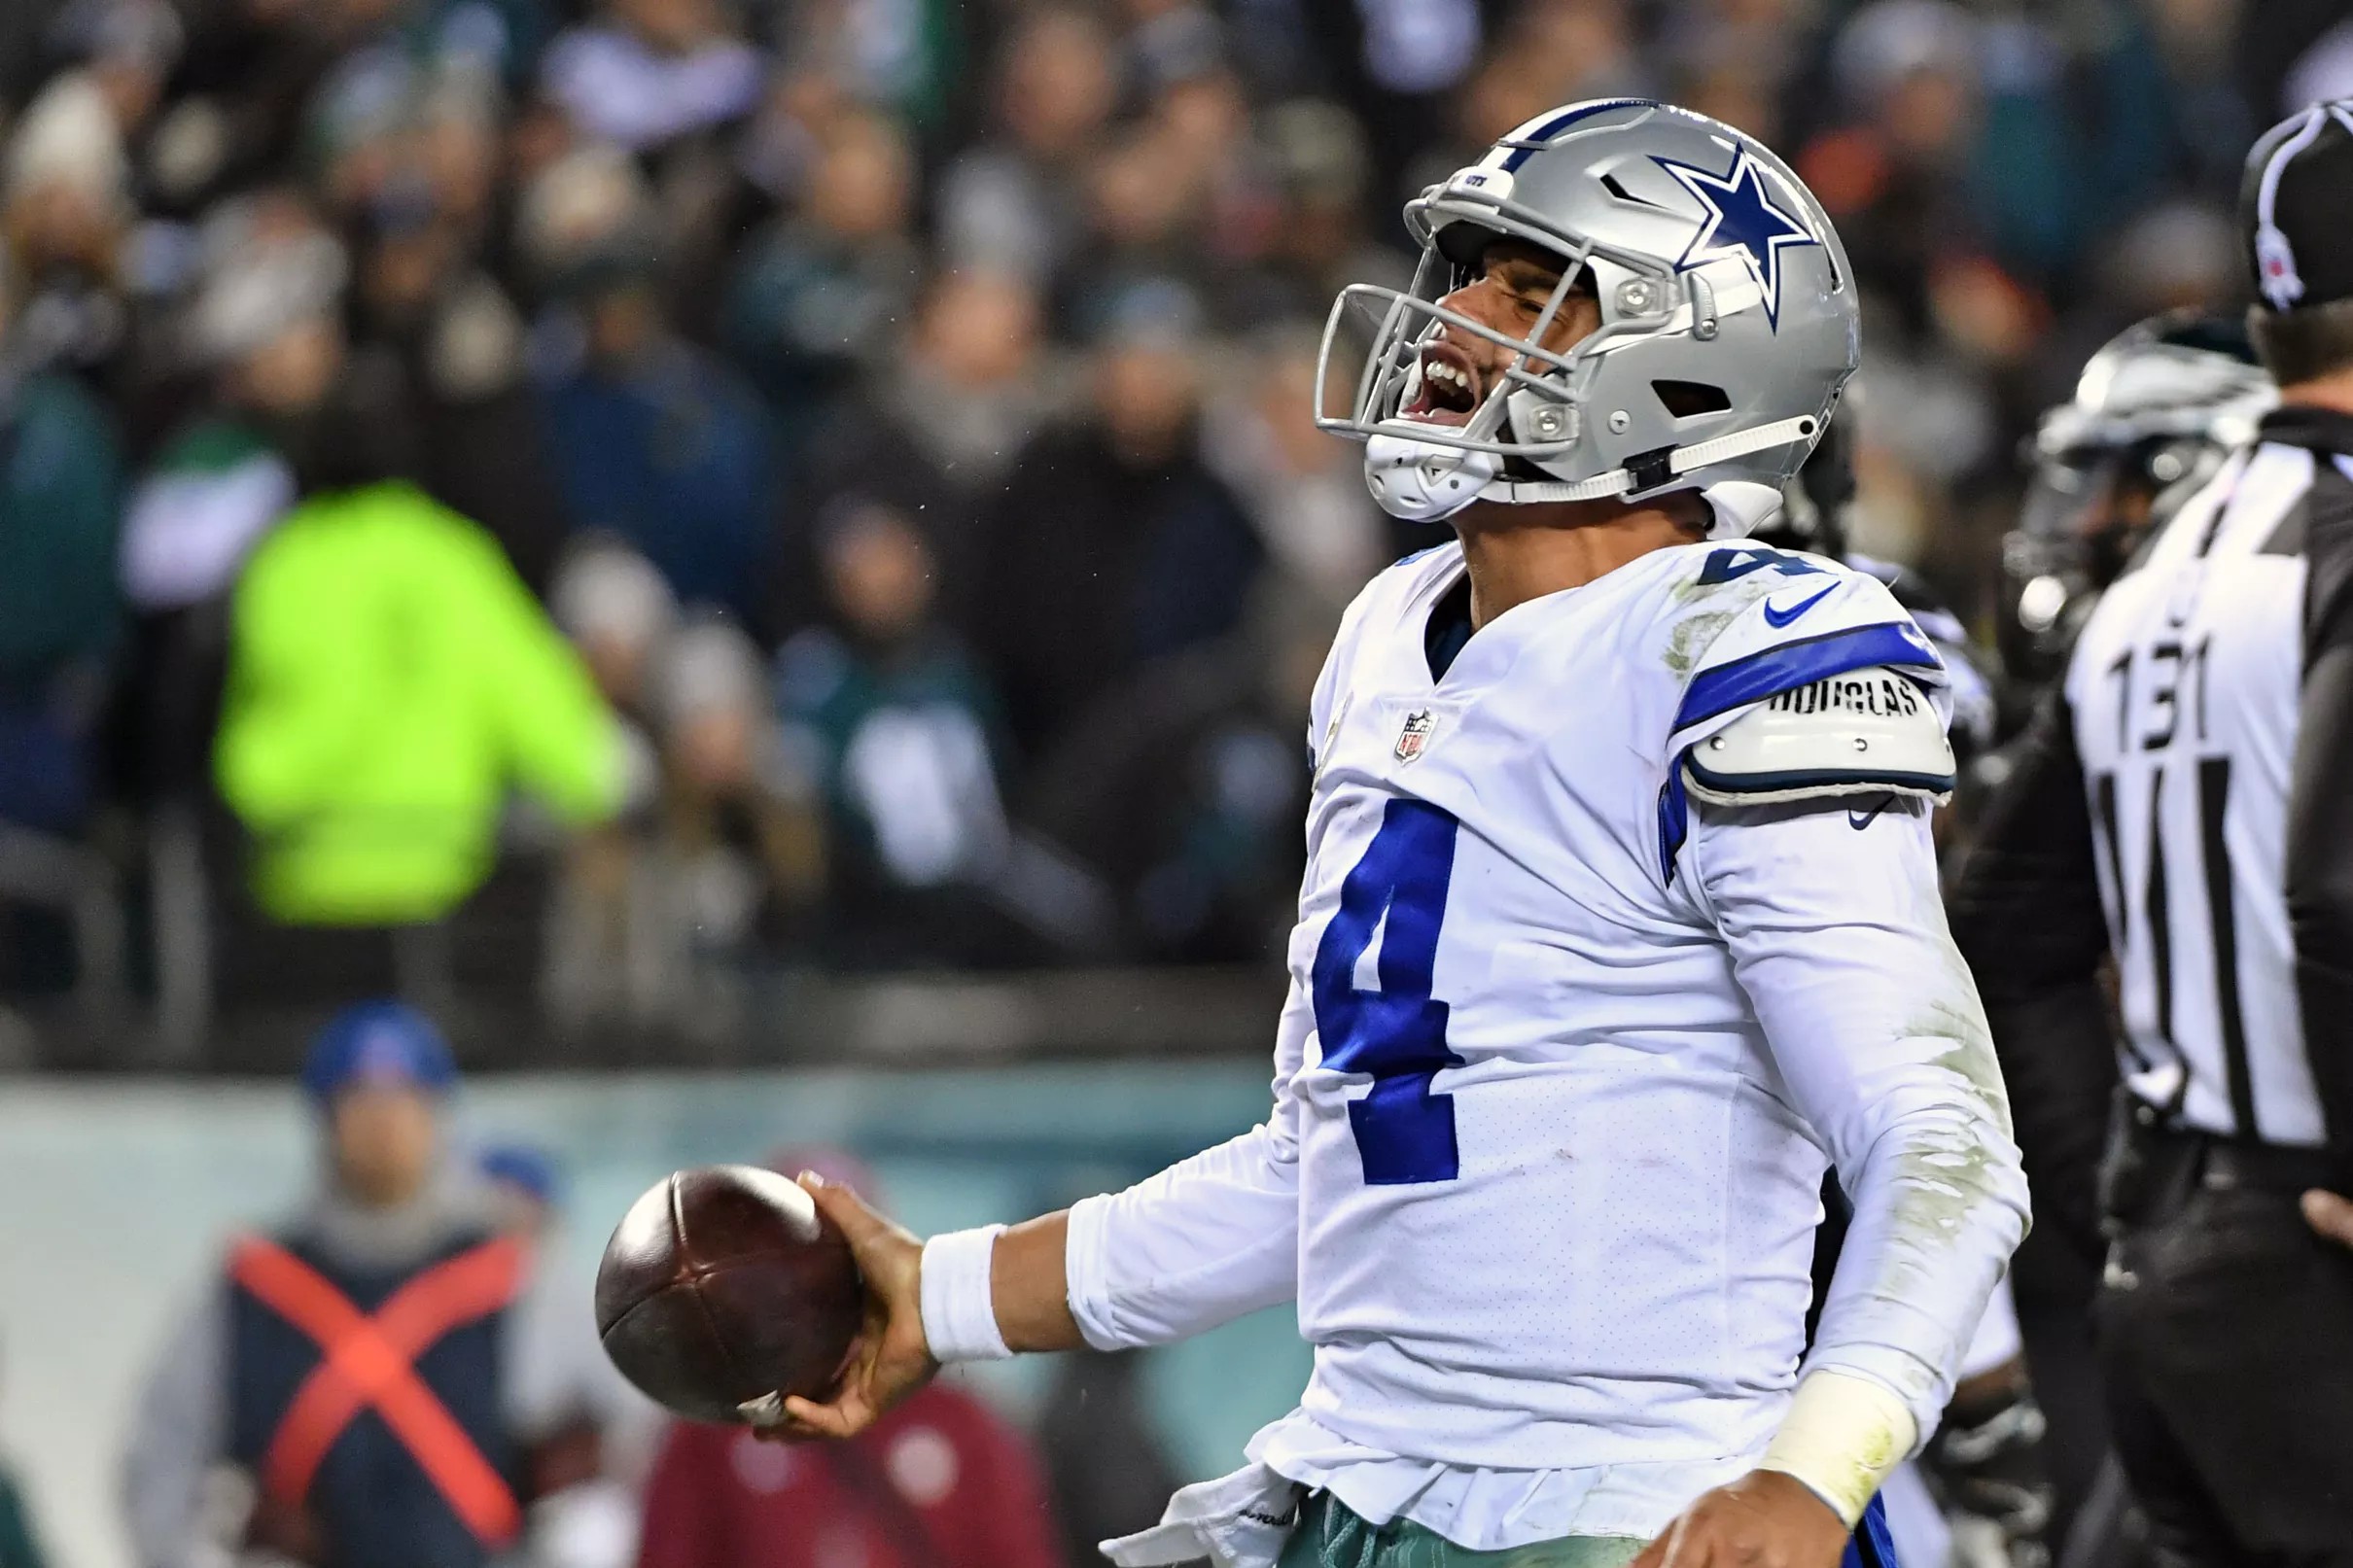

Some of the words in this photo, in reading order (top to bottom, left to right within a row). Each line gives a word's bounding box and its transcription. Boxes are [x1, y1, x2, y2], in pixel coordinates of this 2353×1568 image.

[1698, 548, 1837, 585] 4
[2108, 634, 2211, 752] 131
[1312, 798, 1465, 1184] 4
